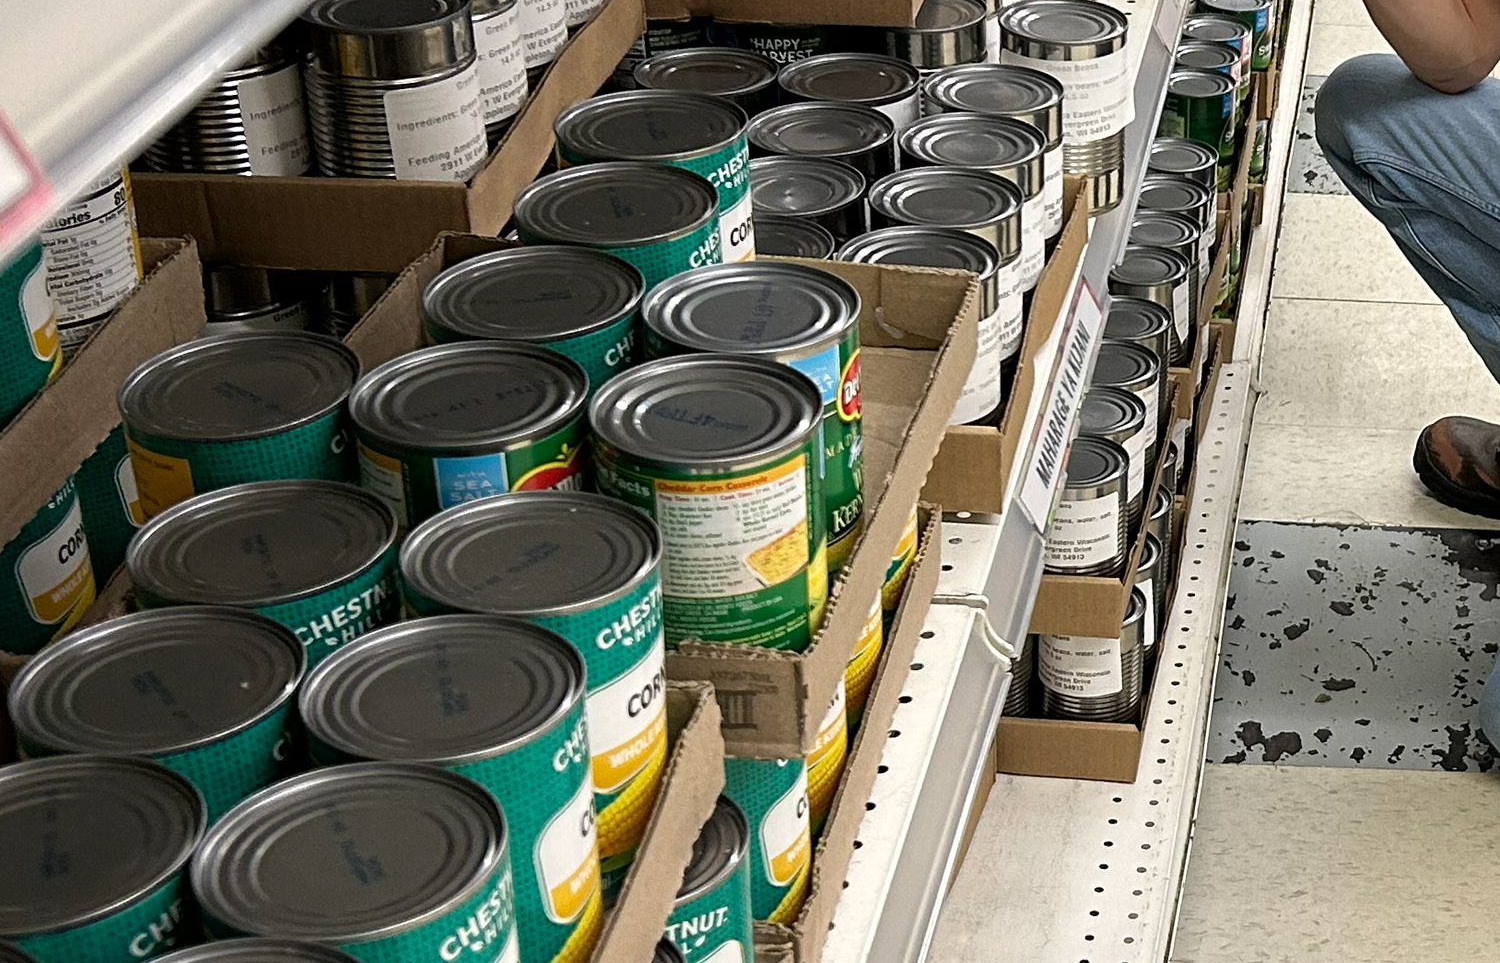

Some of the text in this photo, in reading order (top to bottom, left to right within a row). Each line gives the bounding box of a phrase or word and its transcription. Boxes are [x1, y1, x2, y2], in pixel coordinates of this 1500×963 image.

[753, 38, 800, 51] HAPPY
[758, 48, 814, 64] ARVEST
[397, 110, 459, 132] Ingredients:
[408, 150, 451, 167] Feeding
[440, 158, 464, 172] 2911
[707, 145, 750, 188] CHEST
[1035, 318, 1091, 489] MAHARAGE YA KIJANI
[454, 479, 493, 491] SEA
[611, 470, 651, 497] Facts
[658, 474, 768, 493] Cheddar Corn Casserole
[451, 490, 499, 502] SALT
[58, 526, 84, 565] COR
[294, 579, 387, 647] CHESTN
[595, 581, 663, 650] CHEST
[439, 870, 513, 962] CHEST
[665, 905, 729, 942] TNUT
